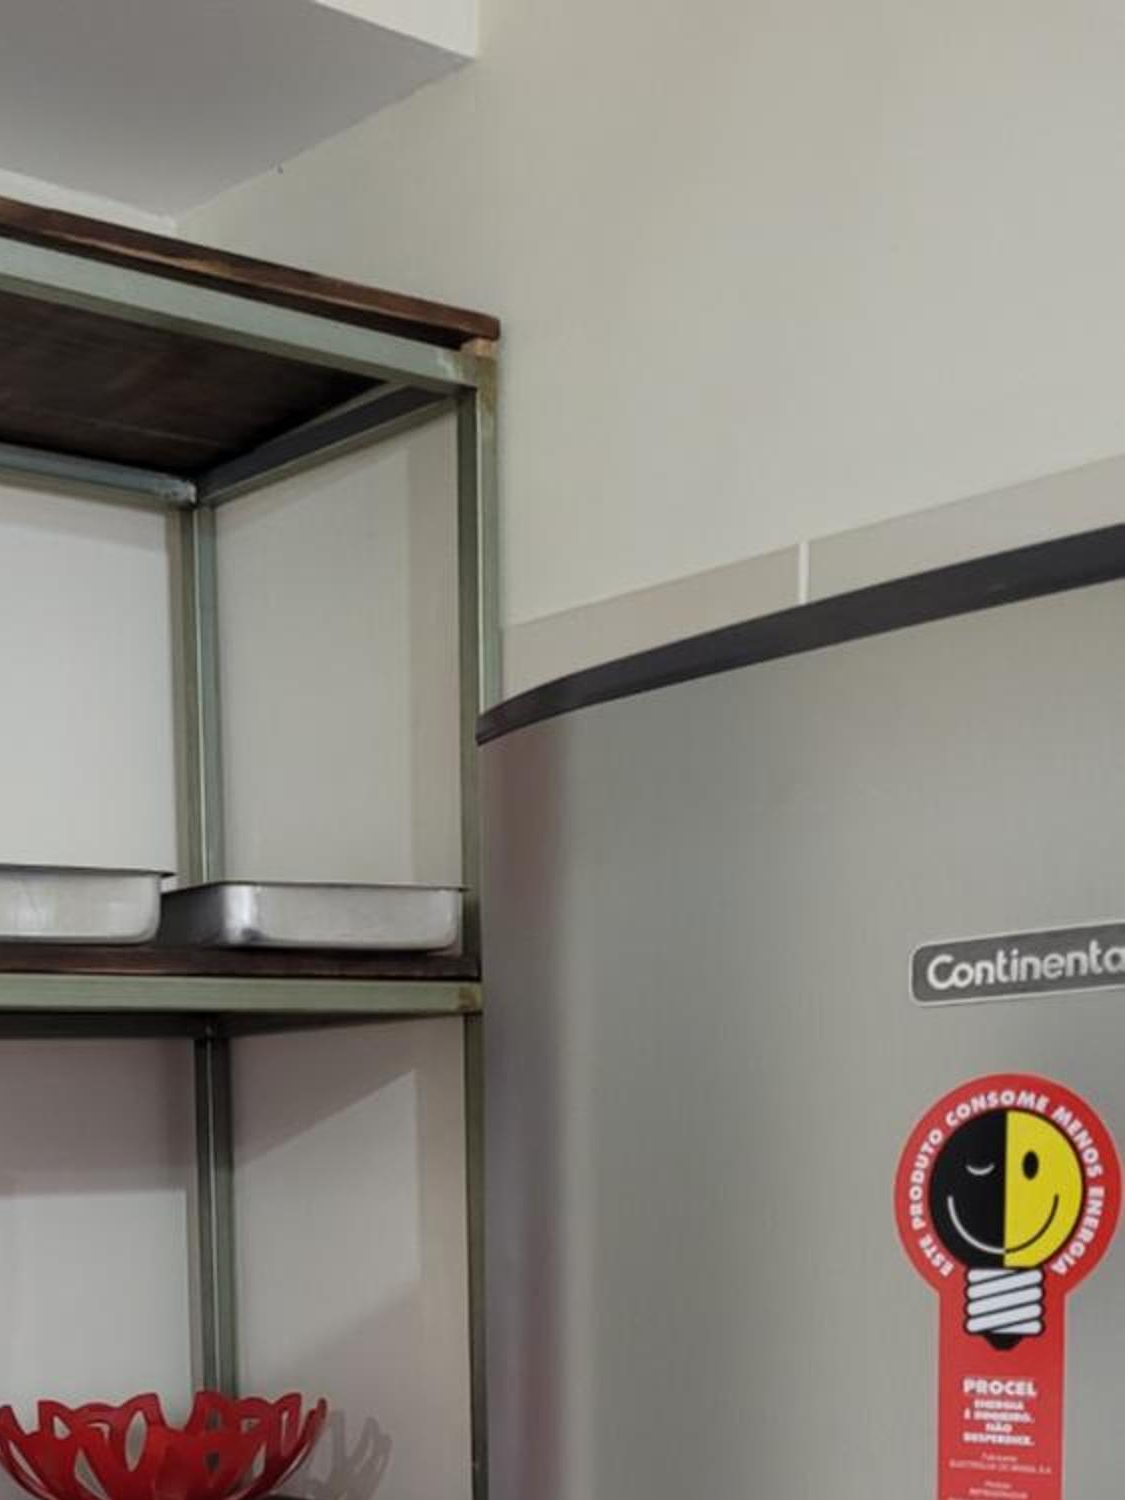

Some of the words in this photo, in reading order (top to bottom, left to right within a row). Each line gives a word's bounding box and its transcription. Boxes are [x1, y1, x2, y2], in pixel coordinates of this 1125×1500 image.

[945, 1089, 1050, 1128] CONSOME
[1050, 1105, 1104, 1179] MENOS
[909, 1128, 943, 1231] PRODUTO
[919, 1233, 955, 1277] ESTE
[1050, 1186, 1106, 1276] ENERGIA
[963, 1378, 1038, 1397] PROCEL
